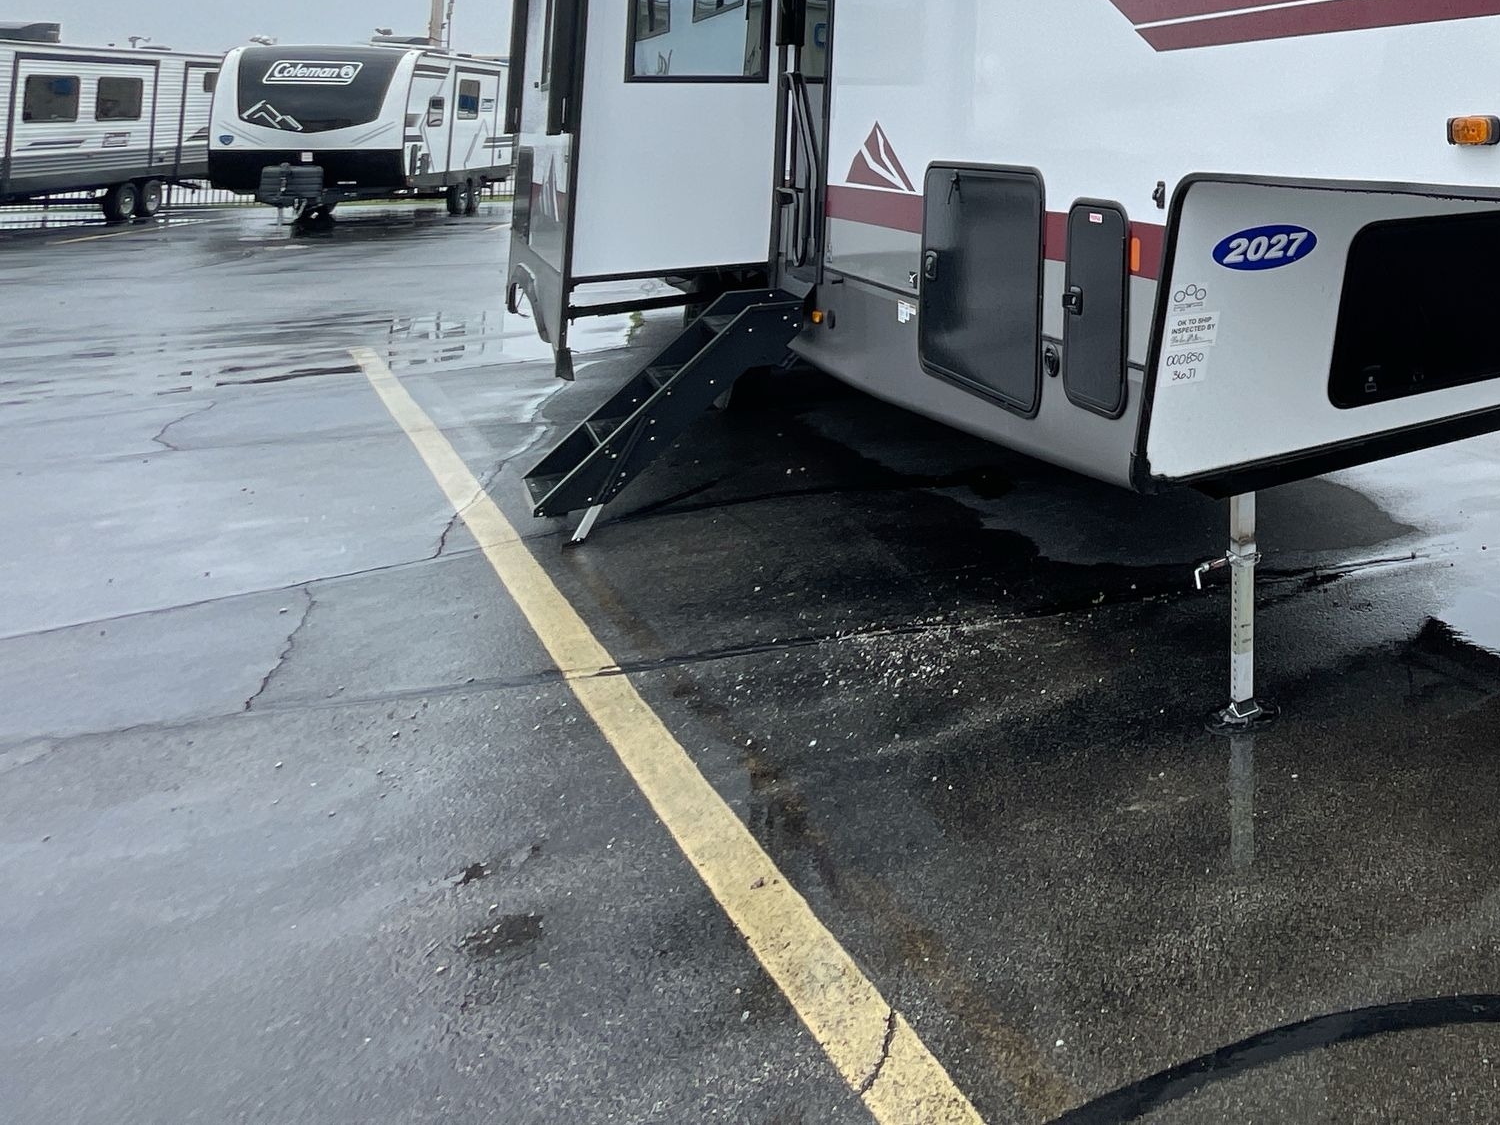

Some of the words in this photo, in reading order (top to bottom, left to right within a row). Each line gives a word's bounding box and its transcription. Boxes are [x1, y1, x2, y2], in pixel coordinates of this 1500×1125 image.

[273, 63, 340, 78] Coleman
[1222, 231, 1308, 264] 2027
[1171, 325, 1206, 335] INSPECTED
[1207, 323, 1216, 331] BY
